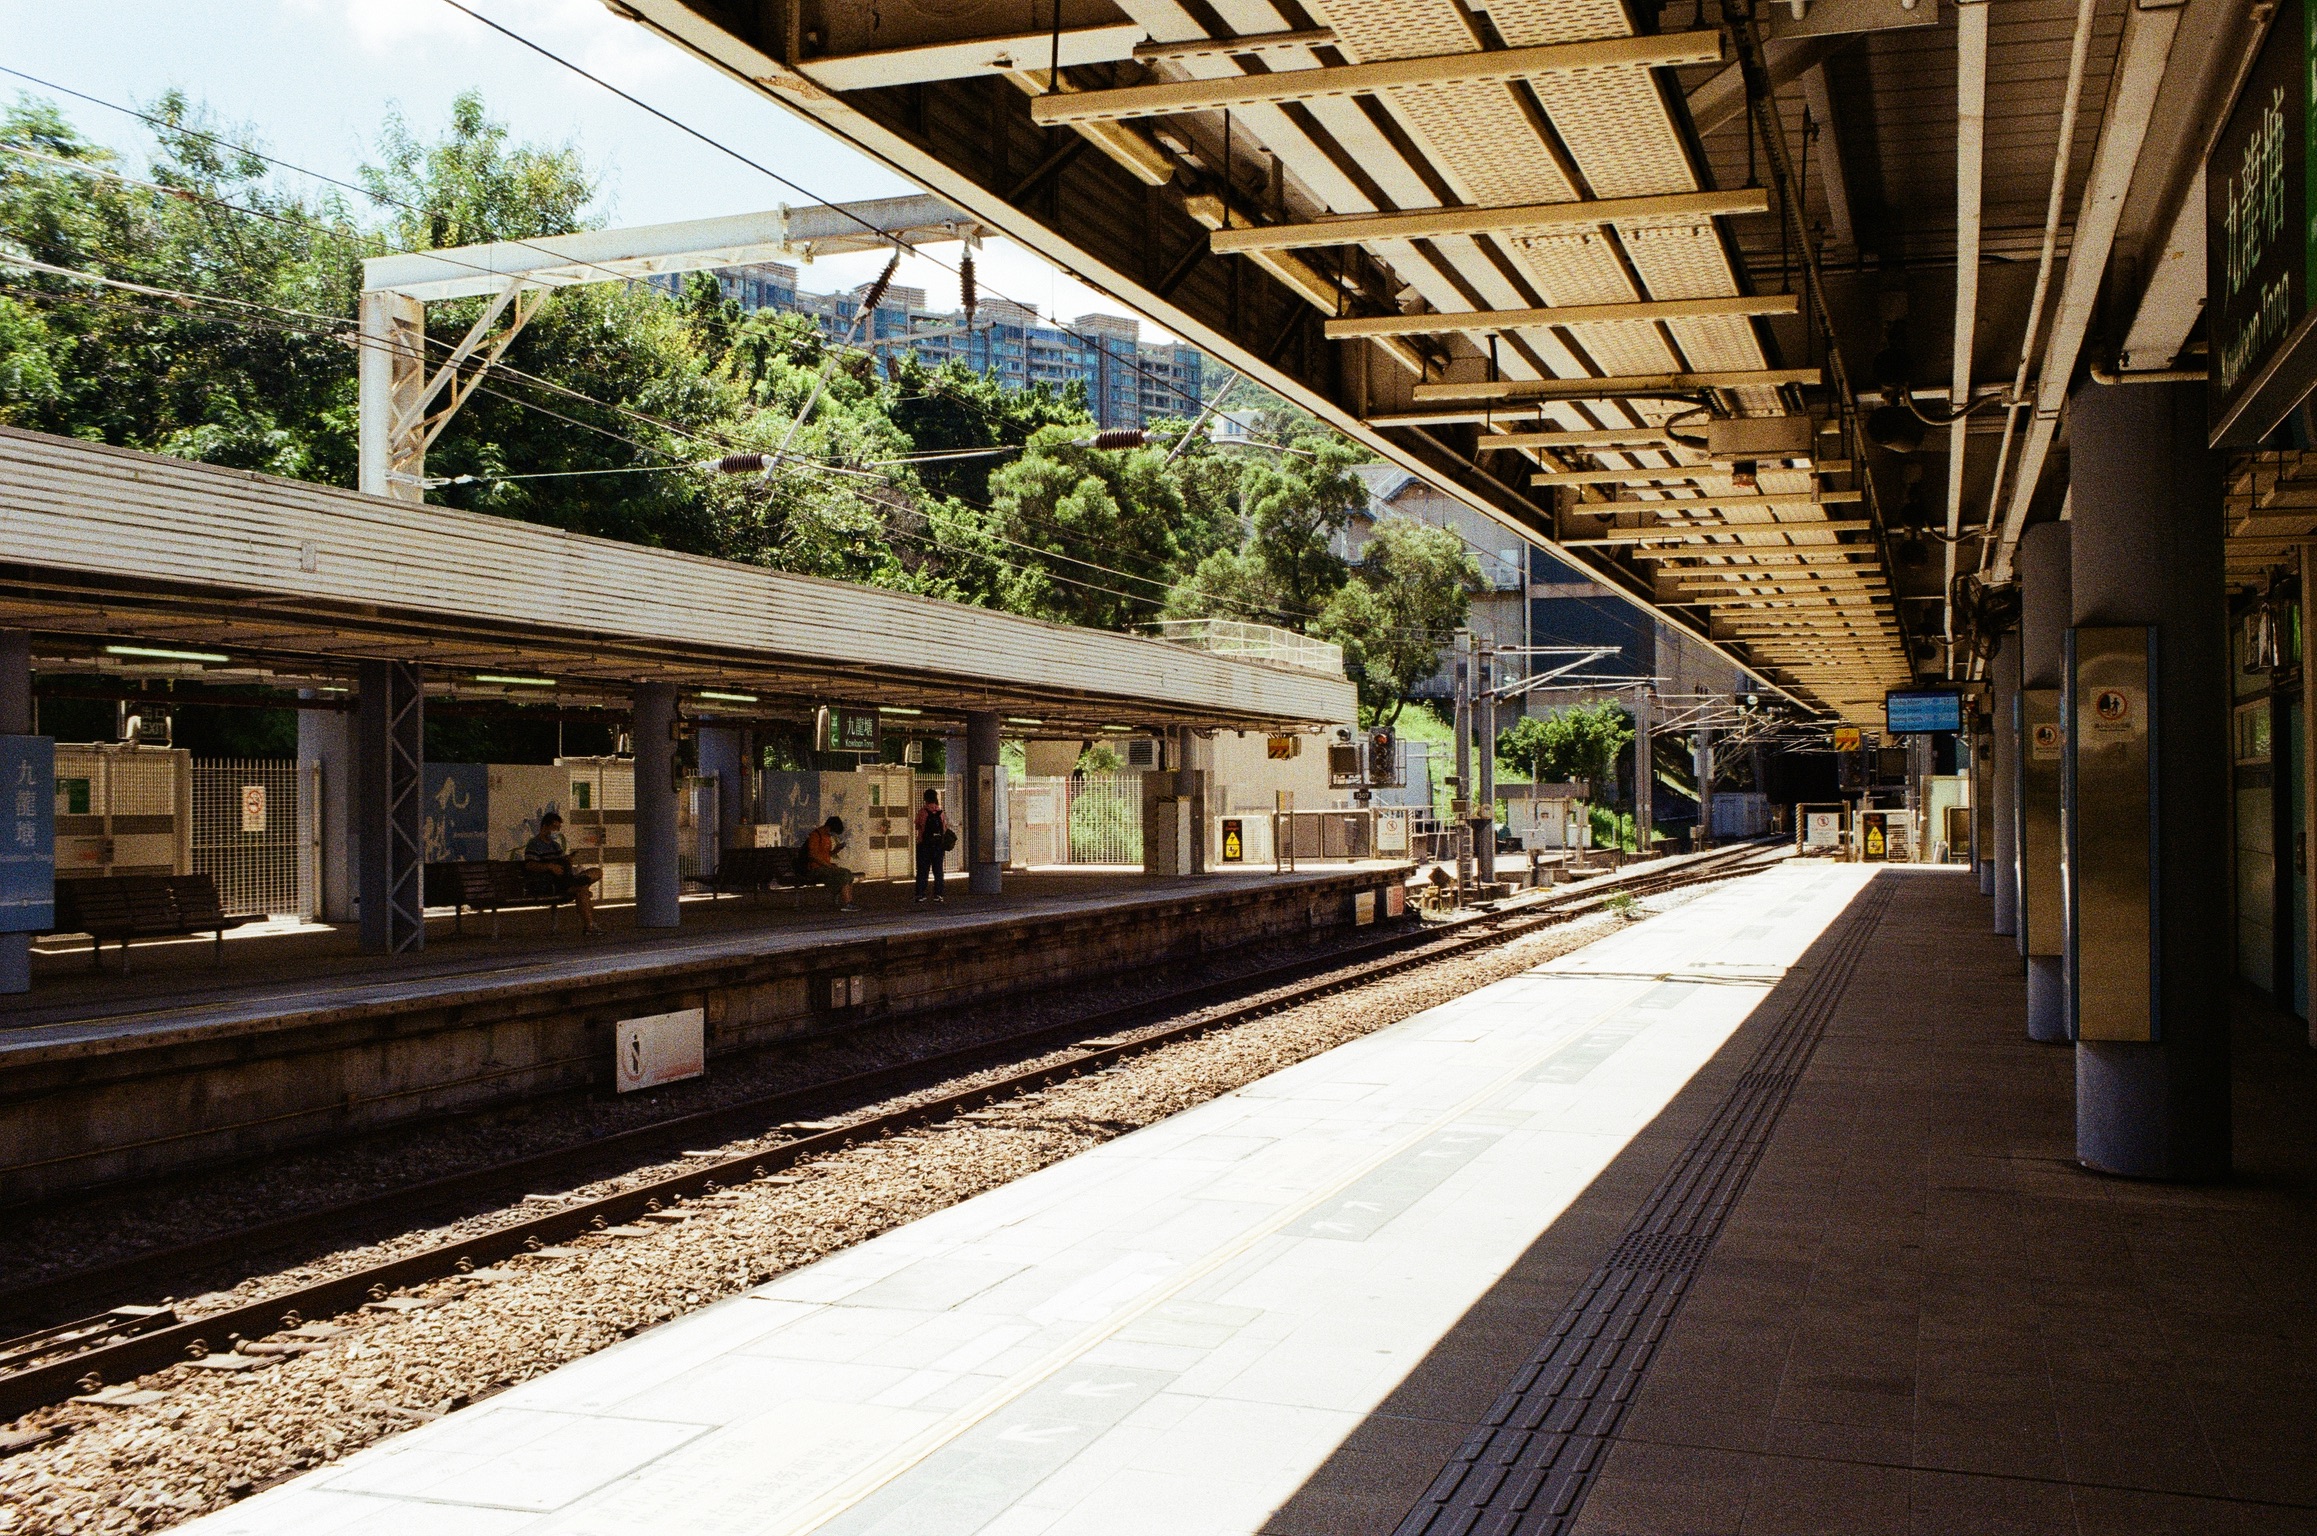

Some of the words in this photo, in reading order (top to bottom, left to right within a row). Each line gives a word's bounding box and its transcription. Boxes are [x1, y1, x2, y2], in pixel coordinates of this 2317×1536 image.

[2224, 86, 2286, 318] 九龍塘
[2261, 270, 2290, 345] Tong
[142, 722, 165, 734] EXIT
[846, 716, 873, 737] 九龍塘
